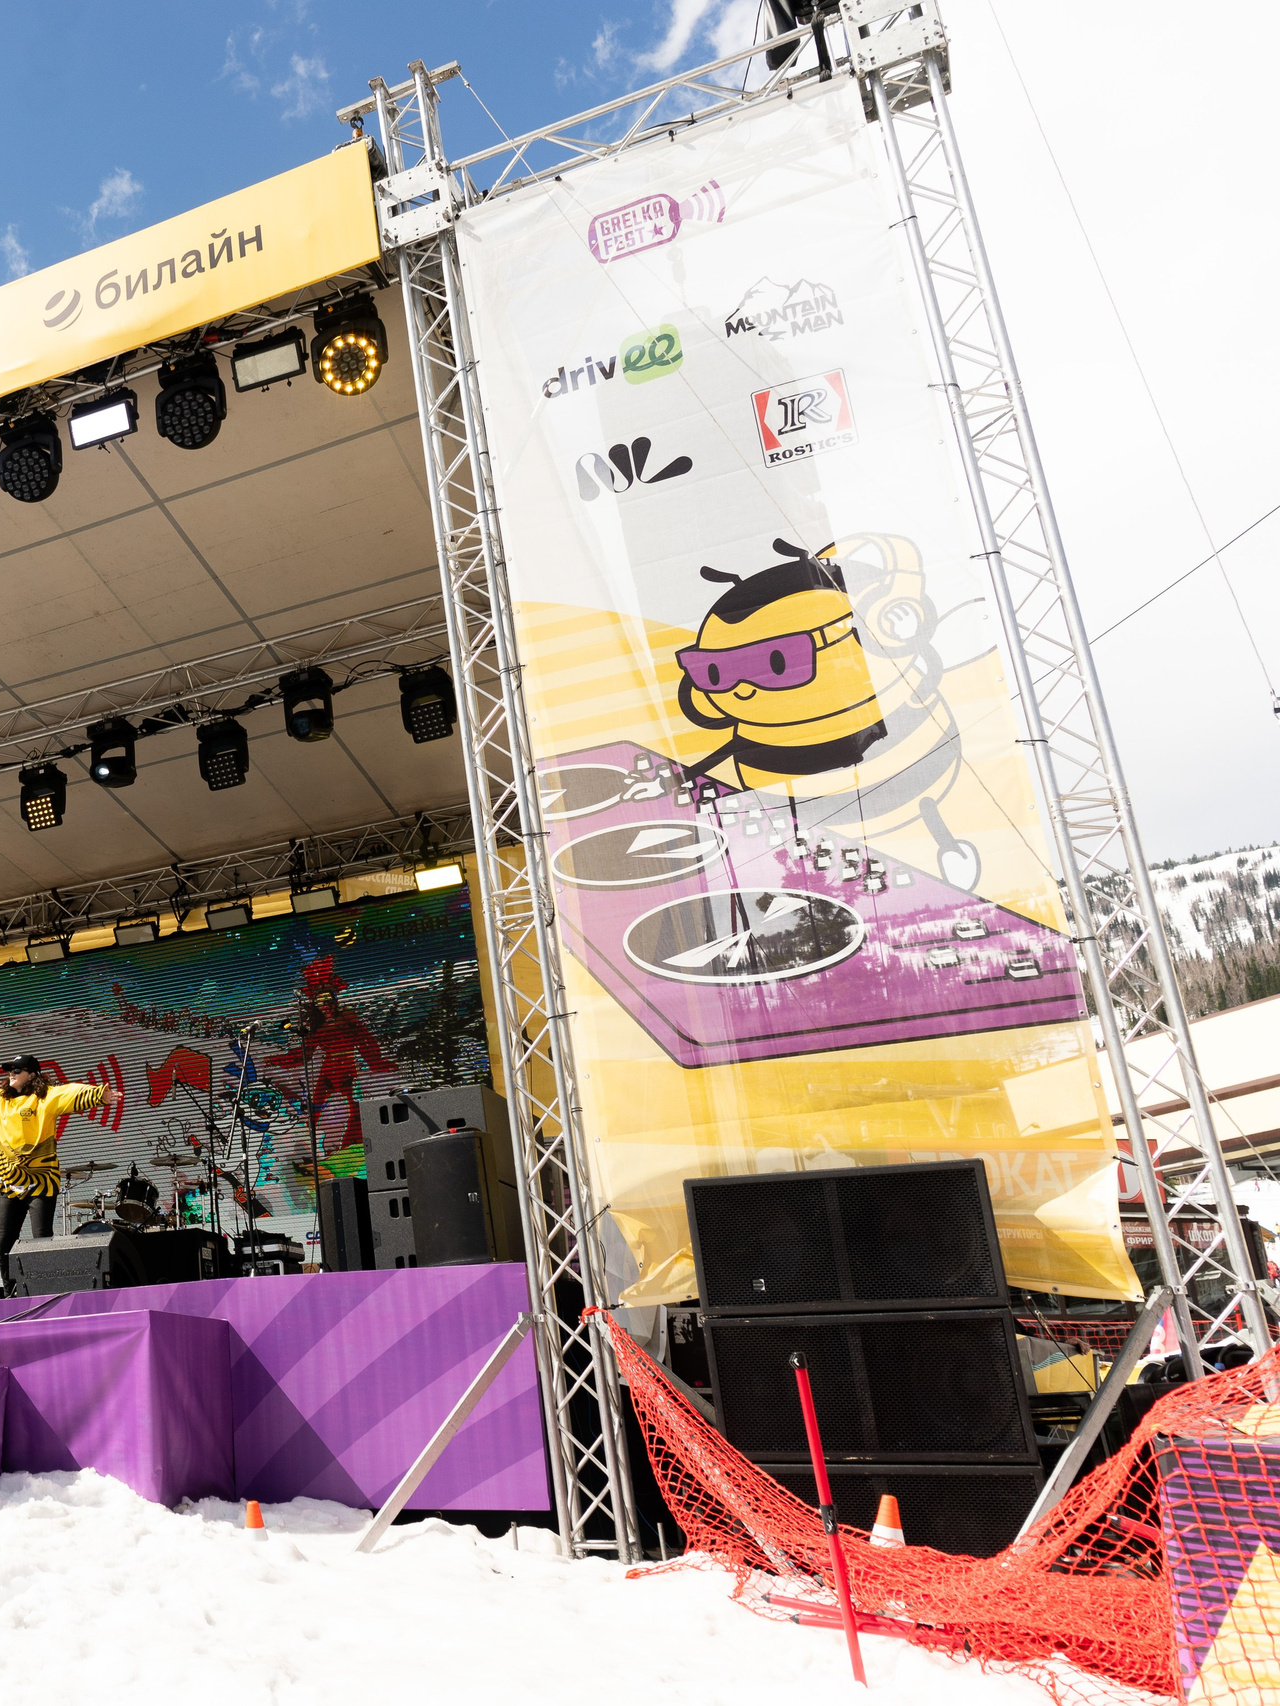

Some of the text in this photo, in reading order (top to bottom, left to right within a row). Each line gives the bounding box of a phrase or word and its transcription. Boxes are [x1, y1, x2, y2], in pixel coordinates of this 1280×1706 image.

[600, 200, 665, 237] GRELKA
[602, 228, 647, 255] FEST
[95, 224, 264, 310] билайн
[725, 293, 839, 338] MOUNTAIN
[791, 309, 845, 337] MAN
[542, 333, 683, 399] drivee
[769, 433, 854, 464] ROSTIC'S
